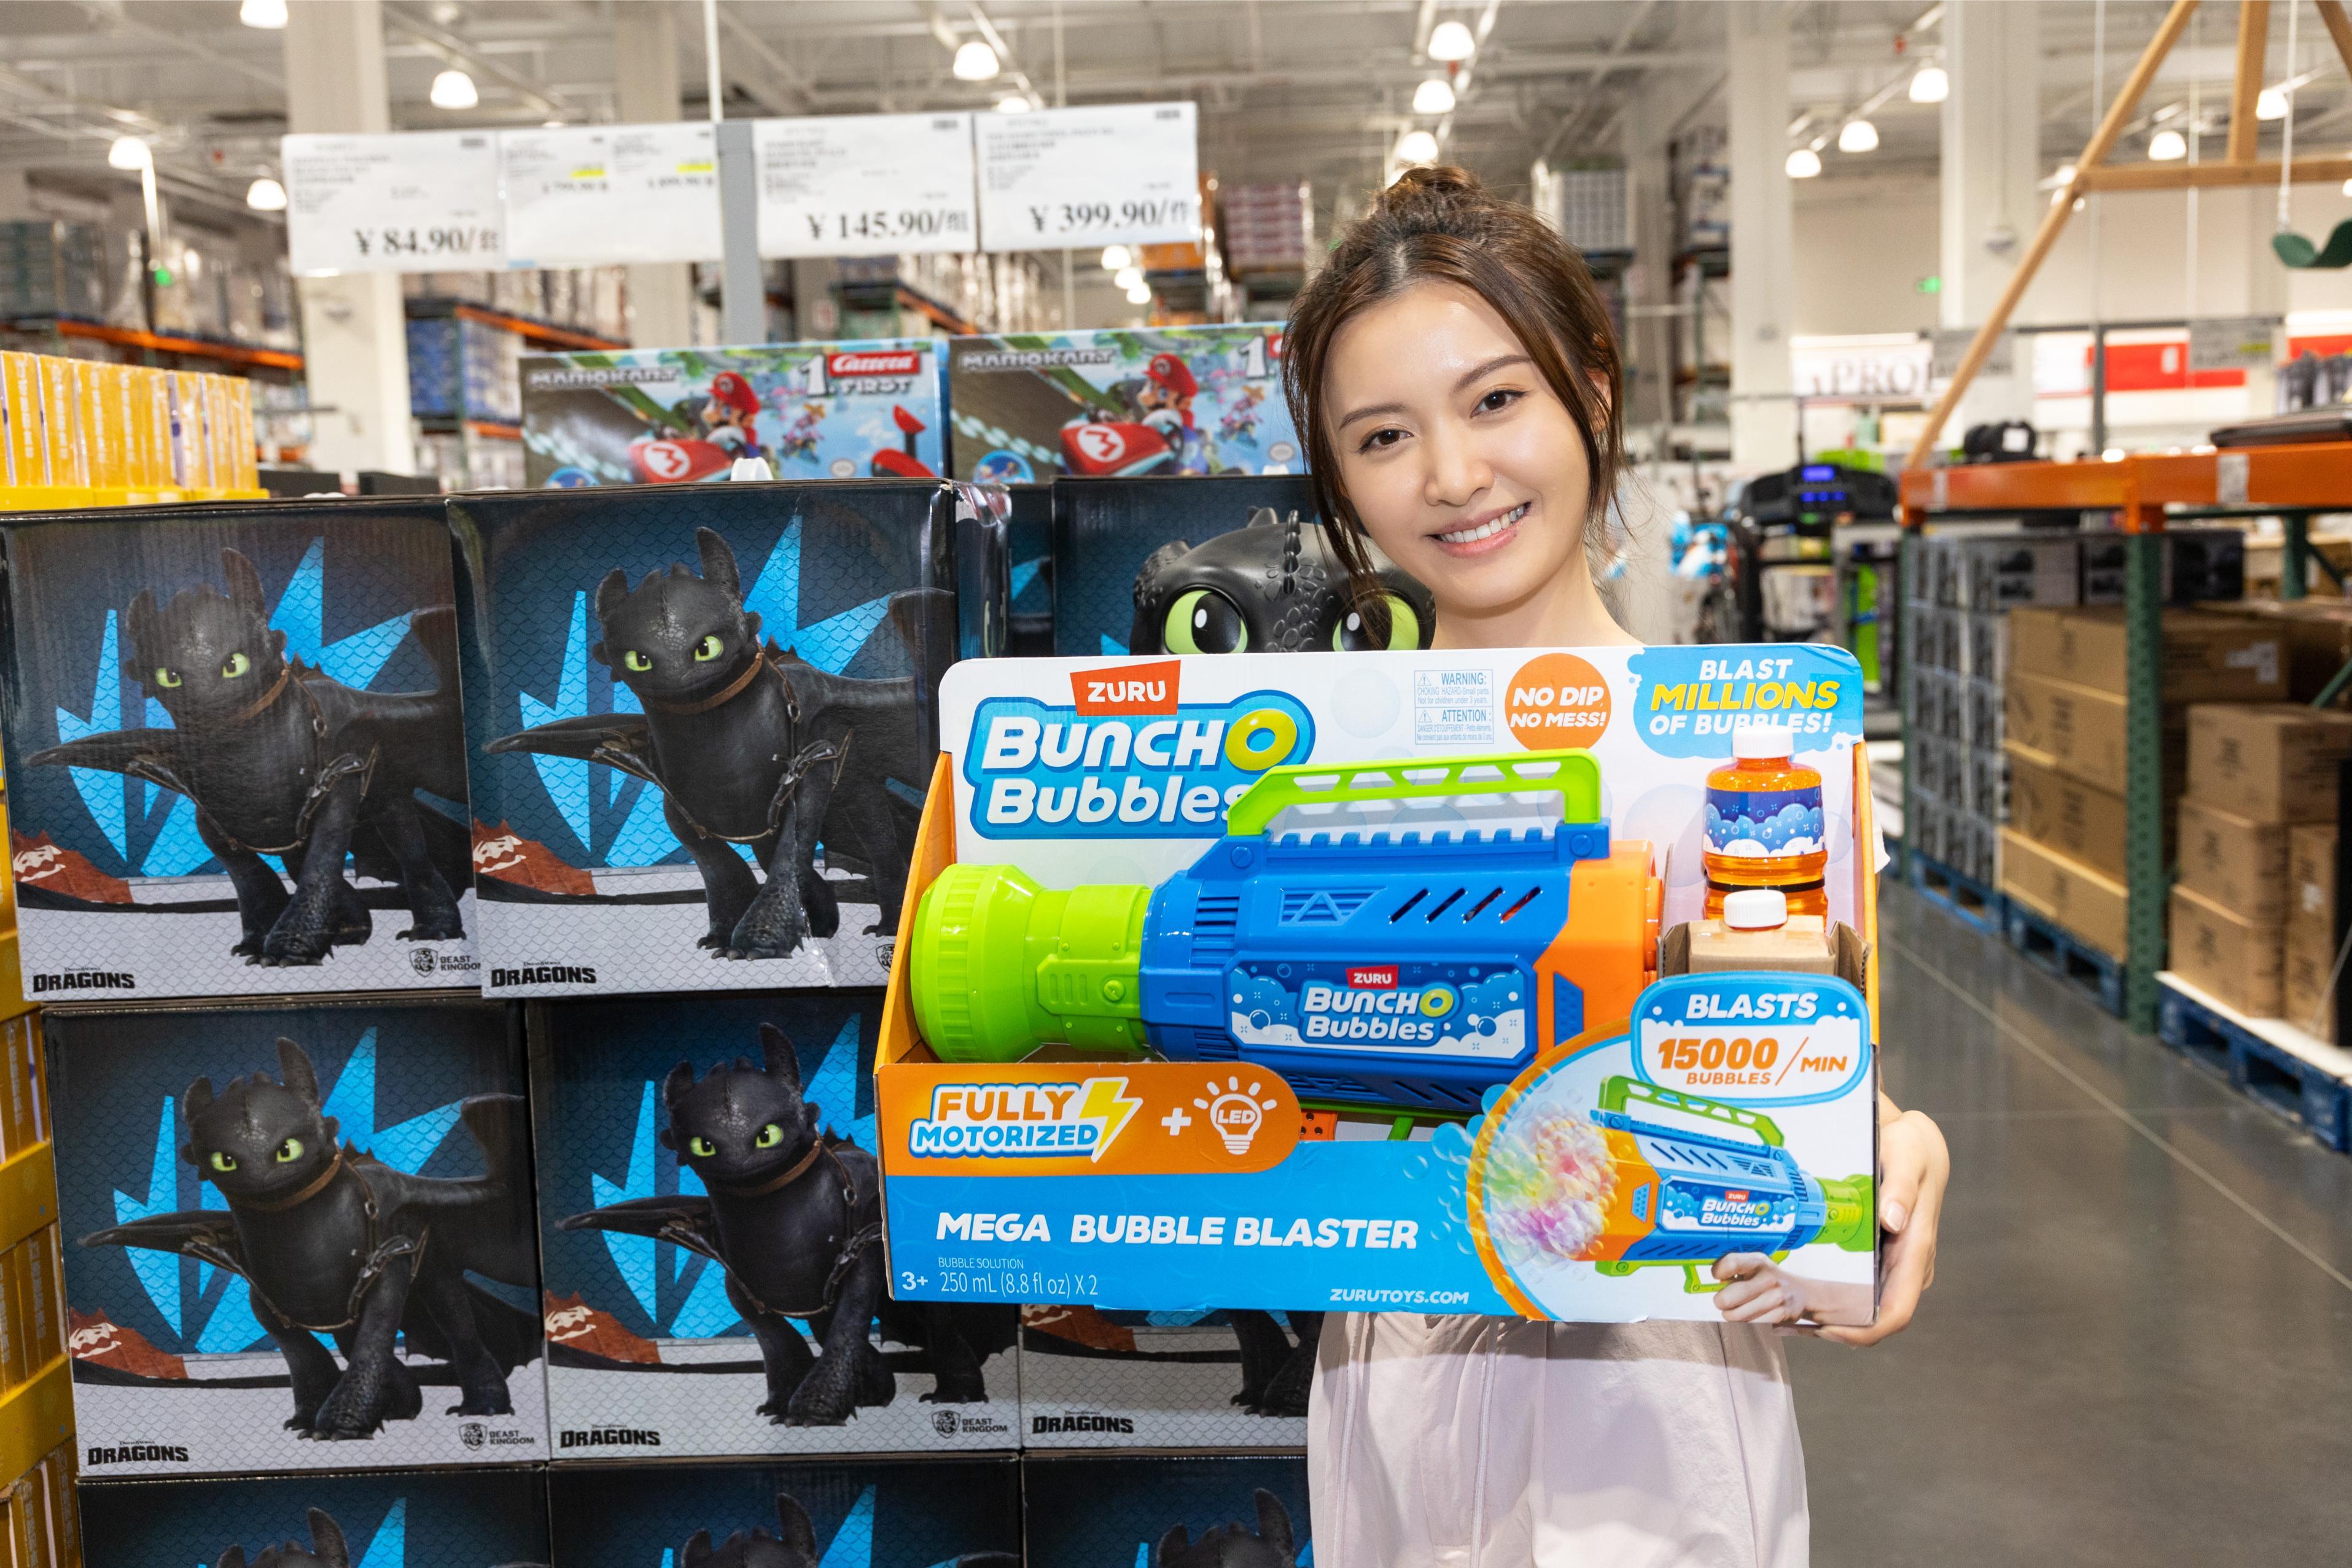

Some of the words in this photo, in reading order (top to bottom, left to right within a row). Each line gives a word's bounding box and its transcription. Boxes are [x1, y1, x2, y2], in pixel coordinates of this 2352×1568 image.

[832, 354, 913, 373] Carrera
[841, 376, 913, 395] FIRST
[1441, 672, 1487, 685] WARNING:
[1699, 658, 1793, 681] BLAST
[1088, 680, 1166, 702] ZURU
[1513, 687, 1554, 707] NO
[1650, 680, 1840, 711] MILLIONS
[1442, 710, 1486, 722] ATTENTION
[1510, 713, 1541, 728] NO
[1545, 712, 1606, 728] MESS!
[1649, 715, 1688, 735] OF
[33, 972, 135, 993] DRAGONS
[491, 966, 596, 987] DRAGONS
[1353, 972, 1392, 985] ZURU
[1686, 993, 1819, 1019] BLASTS
[1306, 1016, 1436, 1041] Bubbles
[1657, 1038, 1778, 1071] 15000
[1800, 1056, 1848, 1073] MIN
[1686, 1073, 1771, 1085] BUBBLES
[937, 1090, 1075, 1122] FULLY
[1217, 1109, 1257, 1124] LED
[916, 1124, 1099, 1147] MOTORIZED
[1701, 1213, 1760, 1226] Bubbles
[937, 1213, 1051, 1241] MEGA
[1070, 1215, 1225, 1245] BUBBLE
[1234, 1217, 1419, 1249] BLASTER
[938, 1257, 975, 1268] BUBBLE
[977, 1258, 1024, 1269] SOLUTION
[901, 1271, 928, 1290] 3+
[940, 1272, 968, 1292] 250
[973, 1274, 997, 1293] mL
[1001, 1272, 1029, 1297] (8.8
[1032, 1272, 1043, 1294] fl
[1048, 1273, 1070, 1299] oz)
[1075, 1275, 1085, 1295] X
[1089, 1275, 1098, 1295] 2
[1330, 1288, 1469, 1305] ZURUTOYS.COM
[1032, 1416, 1134, 1434] DRAGONS
[560, 1429, 661, 1448] DRAGONS
[88, 1445, 189, 1465] DRAGONS
